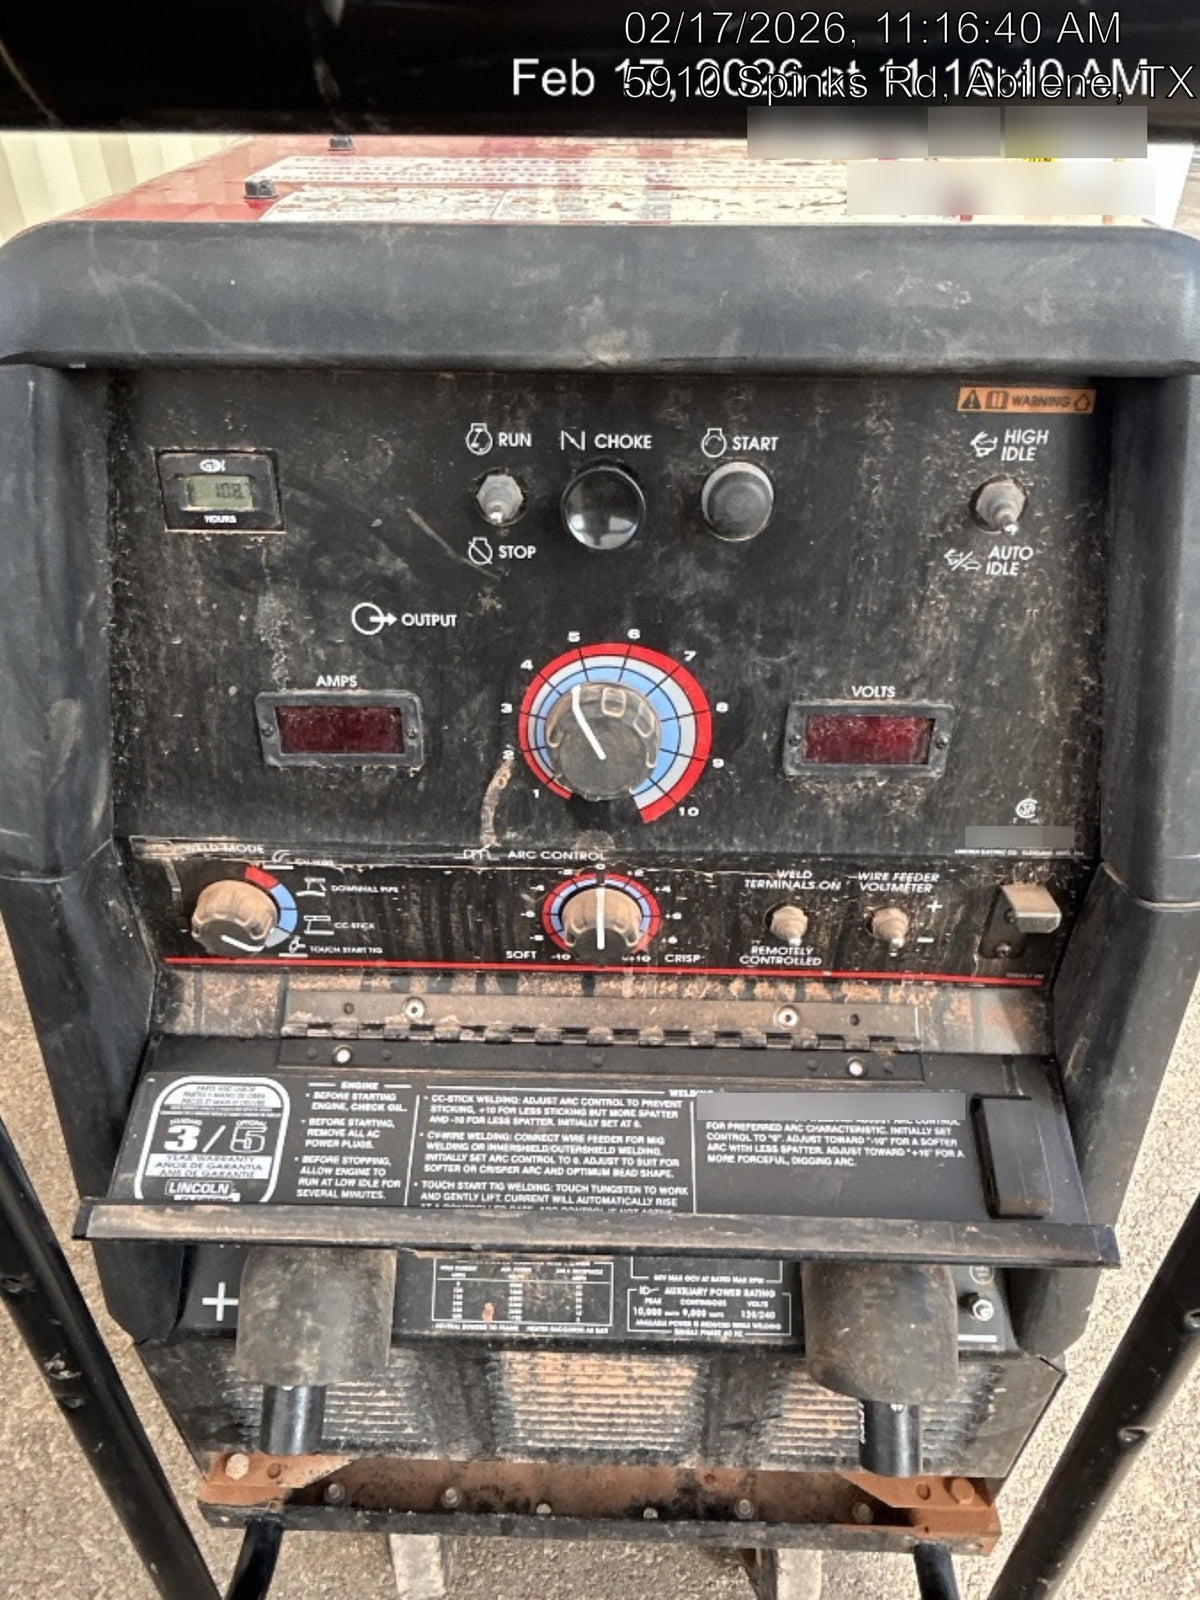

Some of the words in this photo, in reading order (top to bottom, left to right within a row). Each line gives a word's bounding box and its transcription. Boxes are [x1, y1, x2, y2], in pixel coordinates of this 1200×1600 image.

[1011, 395, 1071, 408] WARNING
[498, 432, 532, 448] RUN
[594, 433, 652, 449] CHOKE
[1004, 428, 1050, 445] HIGH
[732, 436, 779, 451] START
[1000, 447, 1037, 462] IDLE
[498, 544, 537, 560] STOP
[988, 546, 1034, 560] AUTO
[985, 562, 1020, 576] IDLE
[401, 614, 458, 627] OUTPUT
[567, 632, 581, 642] 5
[626, 628, 641, 640] 6
[683, 650, 697, 662] 7
[520, 659, 534, 670] 4
[316, 674, 358, 688] AMPS
[851, 686, 896, 698] VOLTS
[500, 703, 513, 714] 3
[712, 758, 725, 768] 9
[532, 788, 540, 798] 1
[678, 806, 700, 817] 10
[508, 850, 537, 860] ARC
[540, 850, 607, 861] CONTROL
[776, 869, 813, 879] WELD
[858, 872, 890, 880] WIRE
[892, 872, 940, 883] FEEDER
[744, 880, 816, 890] TERMINALS
[818, 880, 842, 891] ON
[860, 882, 934, 893] VOLTMETER
[506, 950, 538, 959] SOFT
[750, 946, 814, 956] REMOTELY
[664, 954, 701, 963] CRISP
[739, 955, 822, 966] CONTROLLED
[313, 1092, 350, 1100] BEFORE
[352, 1092, 397, 1101] STARTING
[311, 1102, 349, 1111] ENGINE,
[350, 1103, 385, 1112] CHECK
[522, 1097, 559, 1106] ADJUST
[560, 1097, 579, 1106] ARC
[580, 1098, 626, 1107] CONTROL
[627, 1099, 639, 1107] TO
[641, 1099, 683, 1108] PREVENT
[308, 1118, 345, 1127] BEFORE
[348, 1119, 395, 1128] STARTING,
[706, 1121, 726, 1130] FOR
[726, 1122, 782, 1132] PREFERRED
[784, 1123, 804, 1132] ARC
[890, 1125, 932, 1135] INITIALLY
[934, 1126, 952, 1135] SET
[306, 1128, 346, 1137] REMOVE
[348, 1129, 364, 1138] ALL
[366, 1130, 381, 1138] AC
[514, 1133, 560, 1142] CONNECT
[561, 1134, 586, 1143] WIRE
[587, 1134, 622, 1144] FEEDER
[625, 1135, 644, 1144] FOR
[305, 1139, 340, 1148] POWER
[340, 1140, 375, 1148] PLUGS.
[302, 1155, 340, 1164] BEFORE
[341, 1156, 392, 1165] STOPPING,
[706, 1154, 736, 1164] MORE
[737, 1155, 790, 1165] FORCEFUL,
[791, 1156, 832, 1166] DIGGING
[300, 1166, 333, 1175] ALLOW
[334, 1167, 370, 1176] ENGINE
[372, 1167, 386, 1176] TO
[424, 1164, 460, 1173] SOFTER
[463, 1164, 477, 1173] OR
[479, 1165, 520, 1174] CRISPER
[522, 1166, 542, 1174] ARC
[544, 1166, 564, 1175] AND
[566, 1167, 611, 1176] OPTIMUM
[612, 1168, 638, 1177] BEAD
[168, 1182, 230, 1194] LINCOLN
[298, 1178, 318, 1186] RUN
[320, 1178, 332, 1186] AT
[334, 1178, 356, 1187] LOW
[358, 1178, 379, 1187] IDLE
[381, 1179, 401, 1188] FOR
[421, 1180, 456, 1190] TOUCH
[456, 1181, 487, 1190] START
[488, 1182, 506, 1191] TIG
[506, 1182, 554, 1192] WELDING:
[554, 1183, 589, 1193] TOUCH
[590, 1184, 642, 1194] TUNGSTEN
[643, 1185, 657, 1194] TO
[658, 1186, 689, 1195] WORK
[296, 1189, 338, 1198] SEVERAL
[340, 1189, 386, 1199] MINUTES.
[420, 1192, 441, 1201] AND
[442, 1192, 480, 1202] GENTLY
[504, 1194, 550, 1203] CURRENT
[551, 1195, 574, 1204] WILL
[576, 1195, 652, 1206] AUTOMATICALLY
[655, 1197, 678, 1206] RISE
[709, 1287, 742, 1297] POWER
[743, 1288, 776, 1298] RATING
